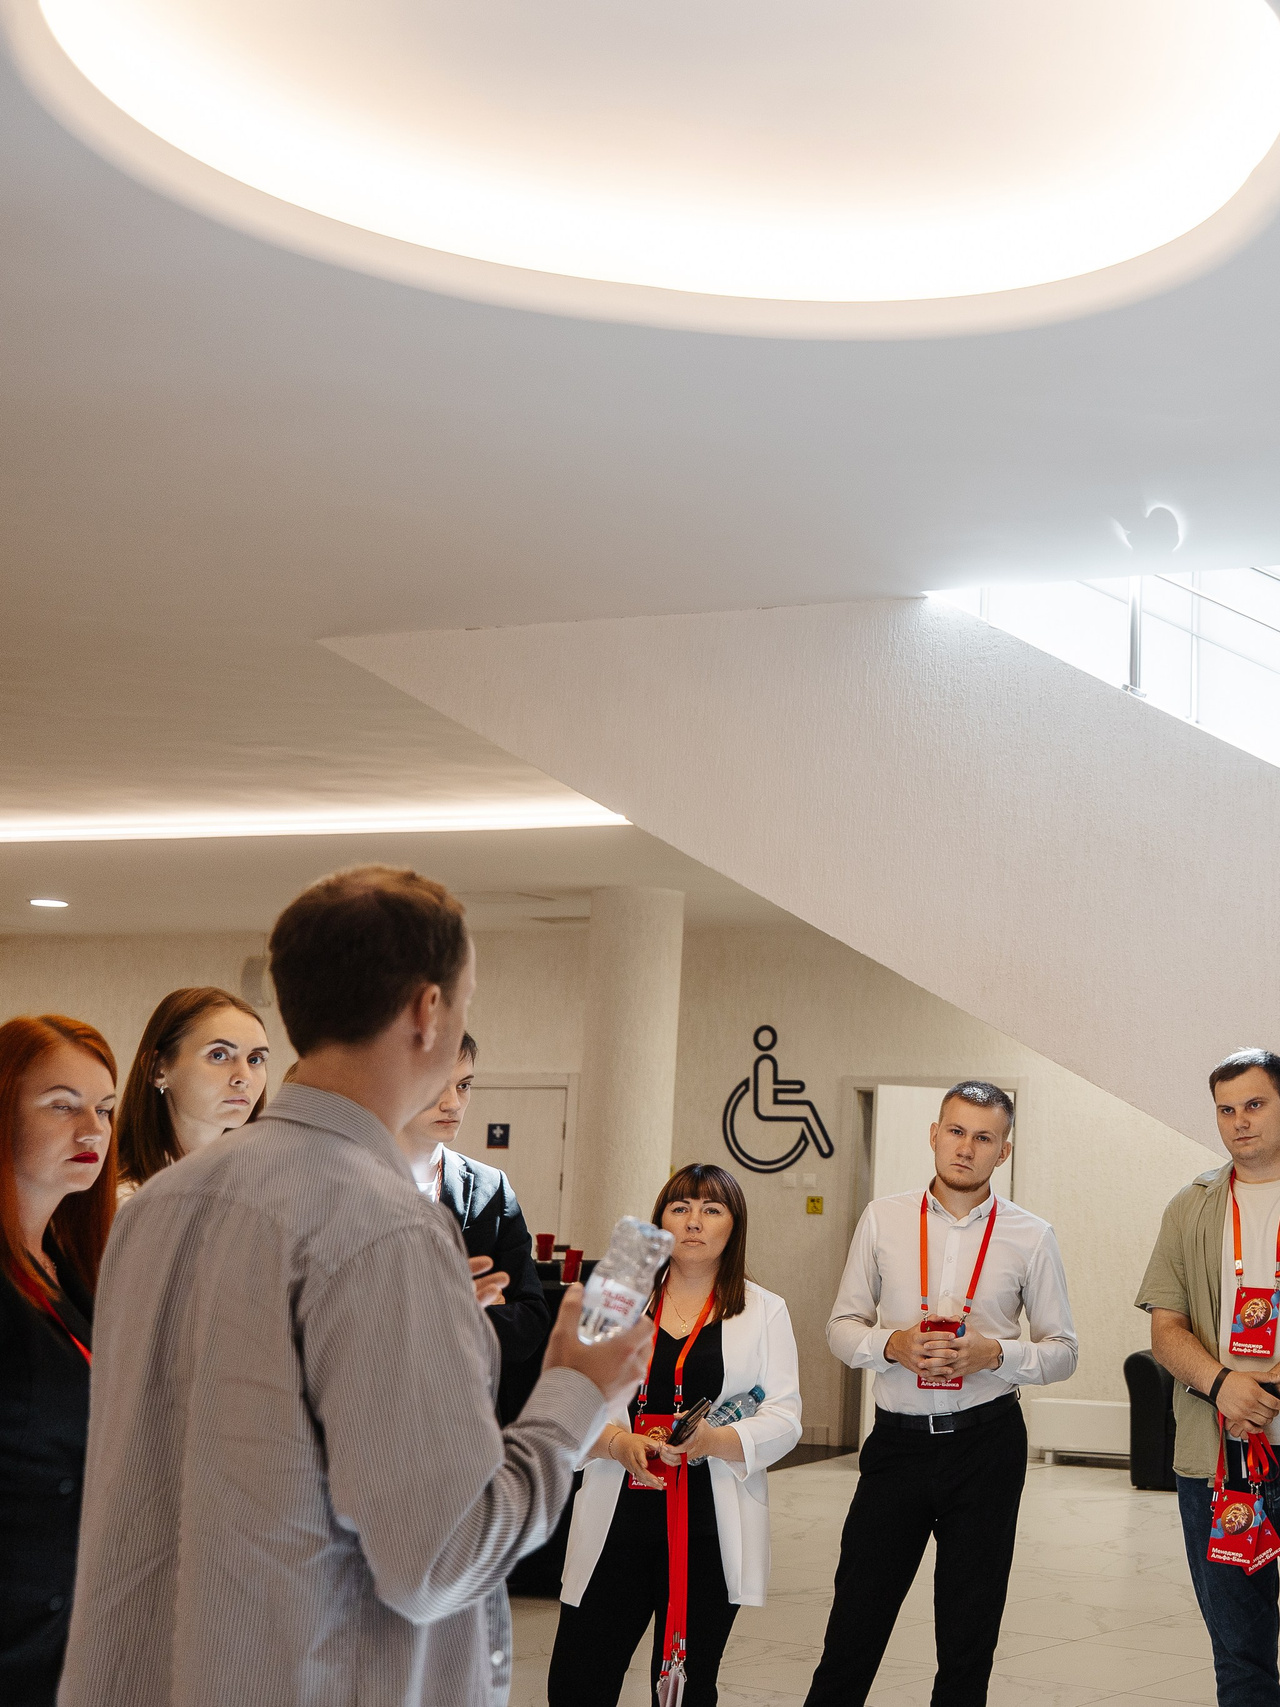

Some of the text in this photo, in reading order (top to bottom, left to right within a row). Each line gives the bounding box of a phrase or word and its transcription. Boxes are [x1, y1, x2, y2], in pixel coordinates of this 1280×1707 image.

[1232, 1341, 1263, 1349] Менеджер
[1231, 1346, 1271, 1355] Альфа-Банка
[1211, 1547, 1243, 1558] Менеджер
[1210, 1552, 1251, 1565] Альфа-Банка
